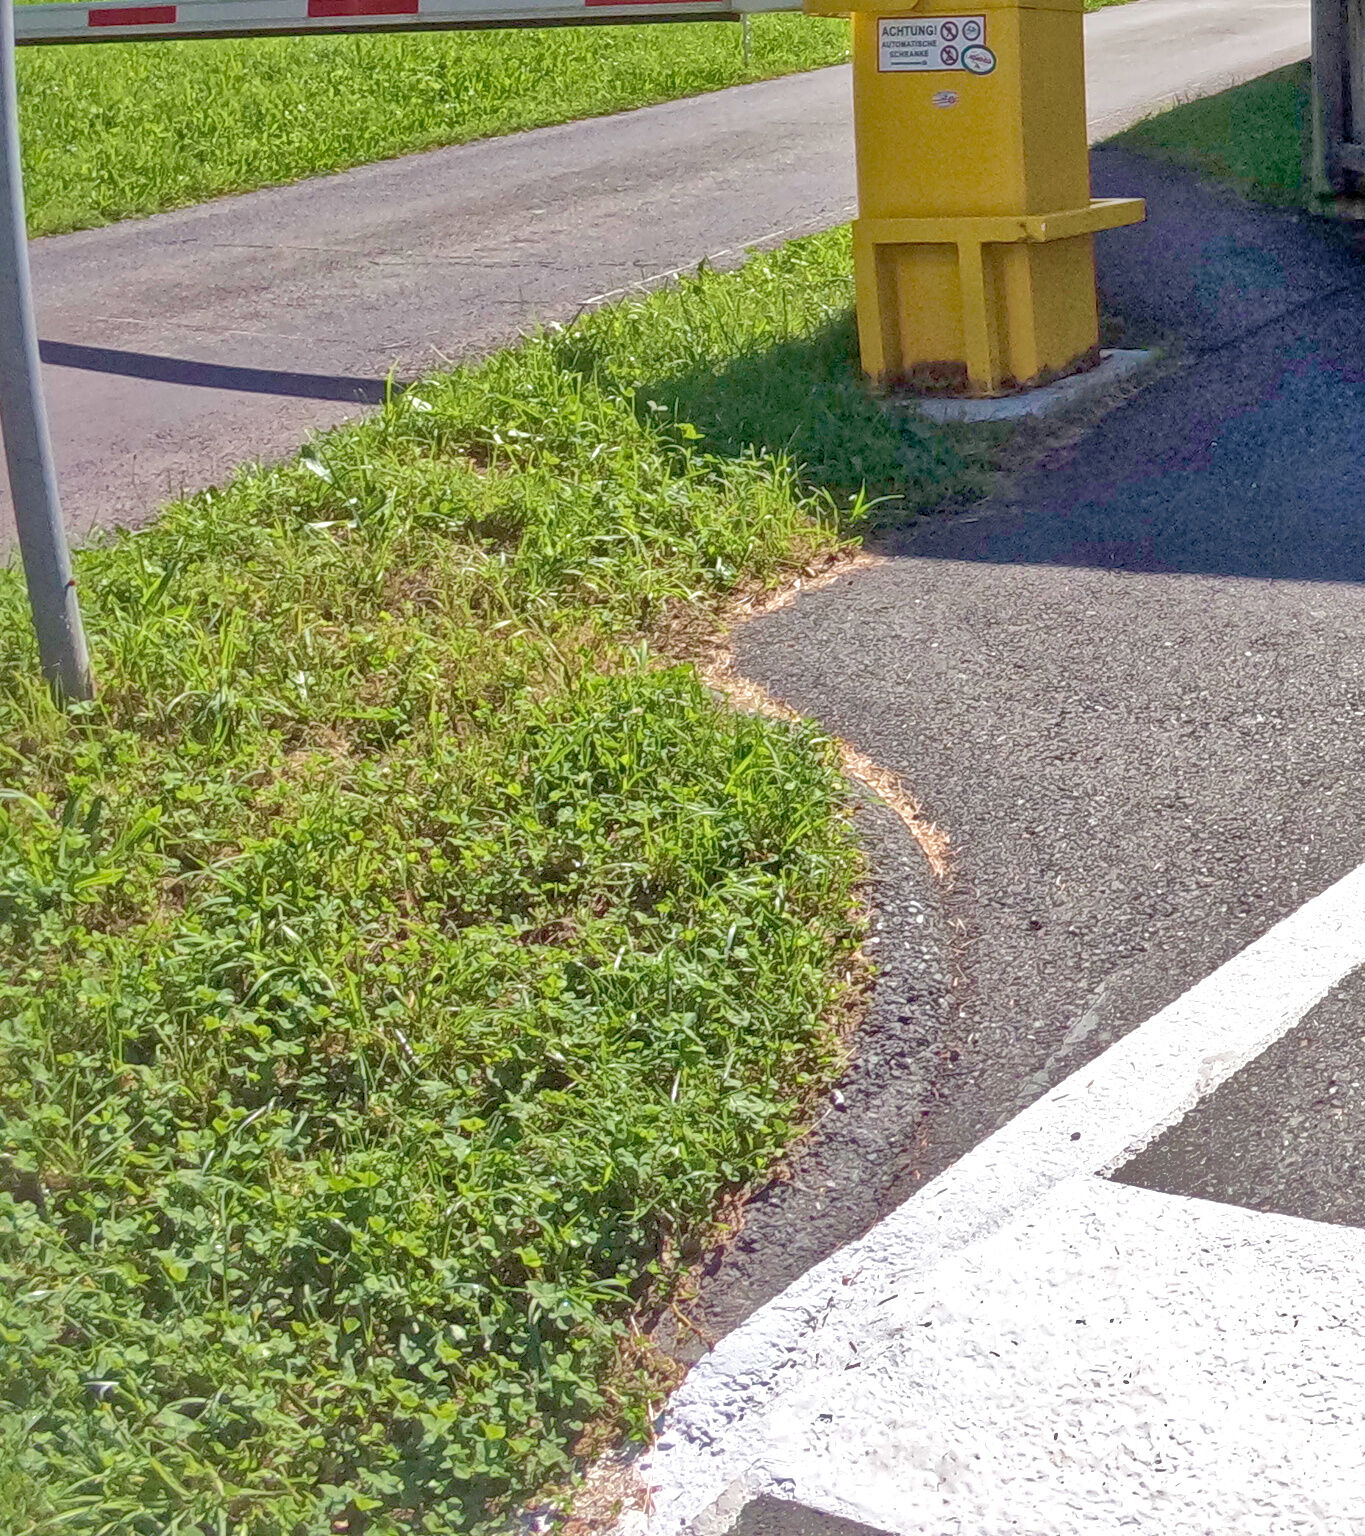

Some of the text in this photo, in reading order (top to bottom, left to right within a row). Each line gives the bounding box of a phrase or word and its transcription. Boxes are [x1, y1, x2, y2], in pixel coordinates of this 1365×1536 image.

[881, 25, 937, 37] ACHTUNG!
[881, 39, 938, 49] AUTOMATISCHE
[889, 50, 929, 59] SCHRANKE
